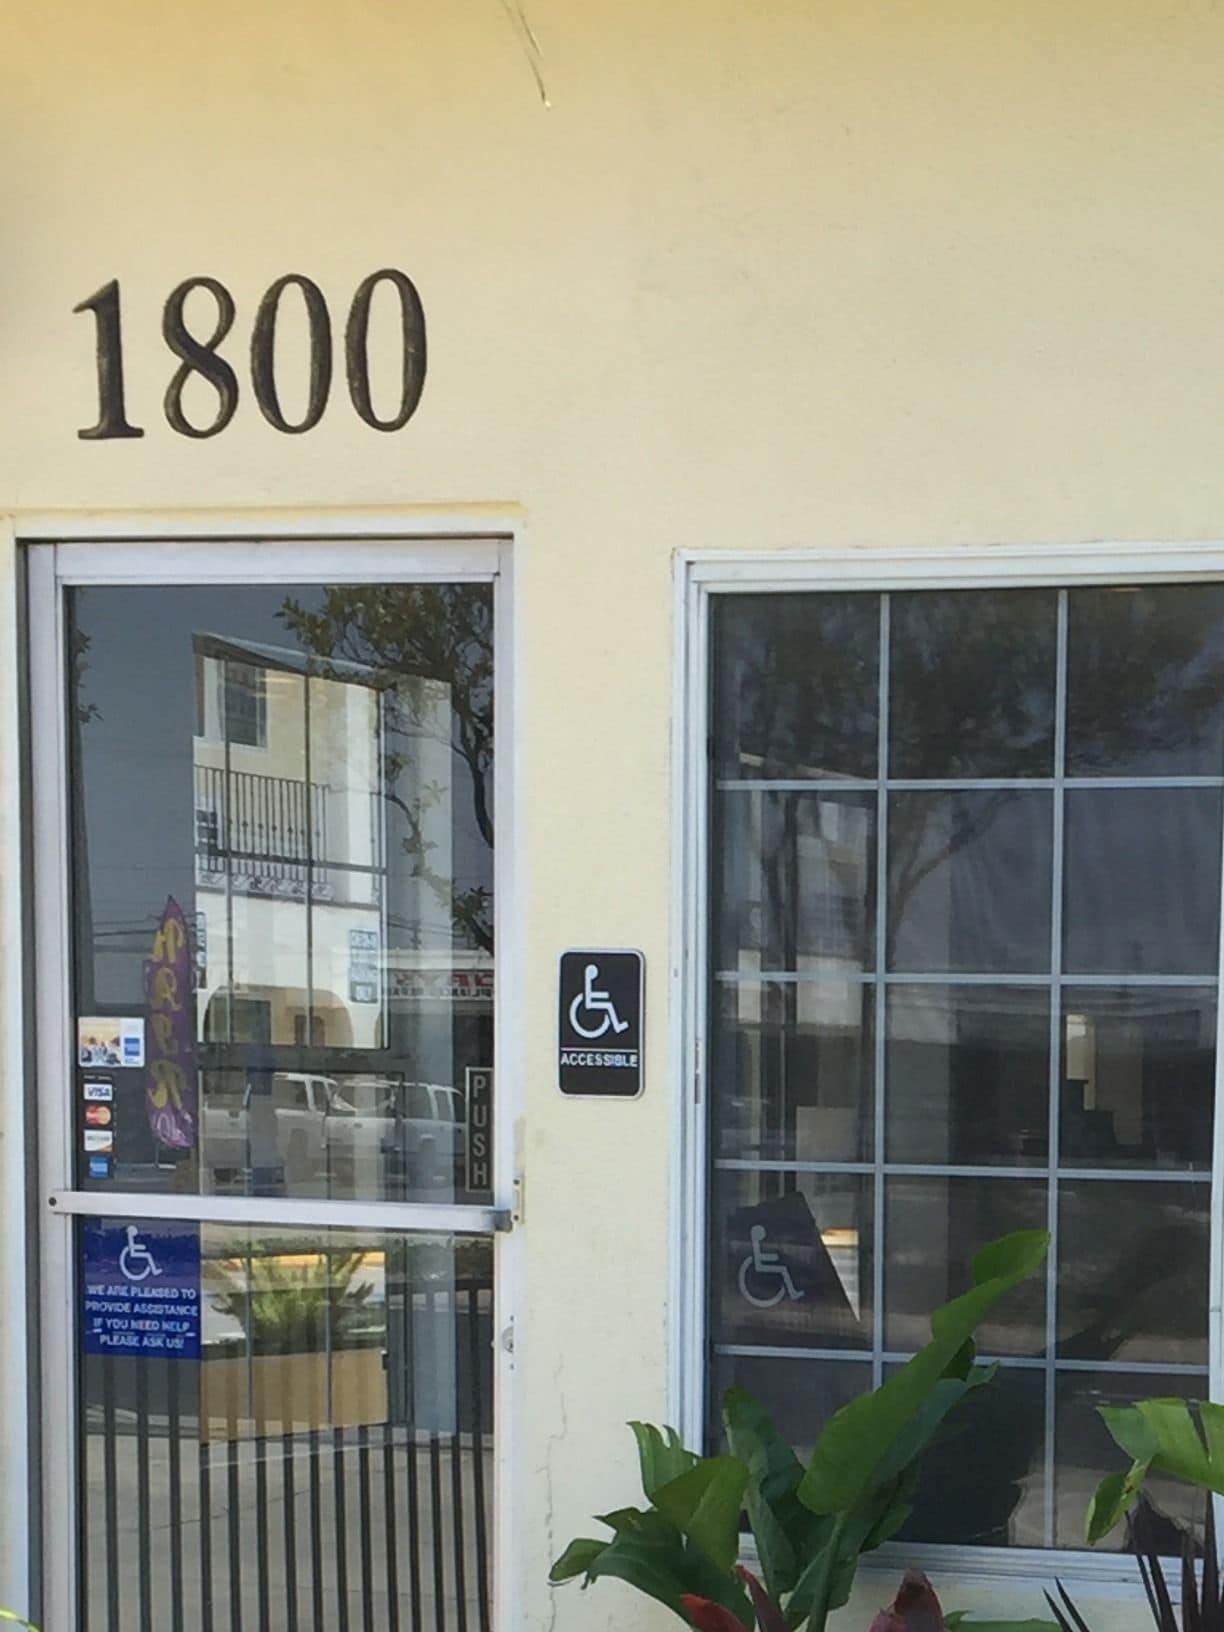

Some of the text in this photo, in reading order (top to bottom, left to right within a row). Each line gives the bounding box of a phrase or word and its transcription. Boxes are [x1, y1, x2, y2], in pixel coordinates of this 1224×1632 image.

[72, 268, 428, 440] 1800
[560, 1052, 638, 1068] ACCESSIBLE
[87, 1086, 111, 1097] VISA
[472, 1074, 488, 1186] PUSH
[87, 1284, 197, 1300] WE ARE PLEASED TO
[85, 1301, 199, 1317] PROVIDE ASSISTANCE
[93, 1318, 191, 1333] IF YOU NEED HELP
[99, 1333, 140, 1347] PLEASE
[142, 1336, 165, 1348] ASK
